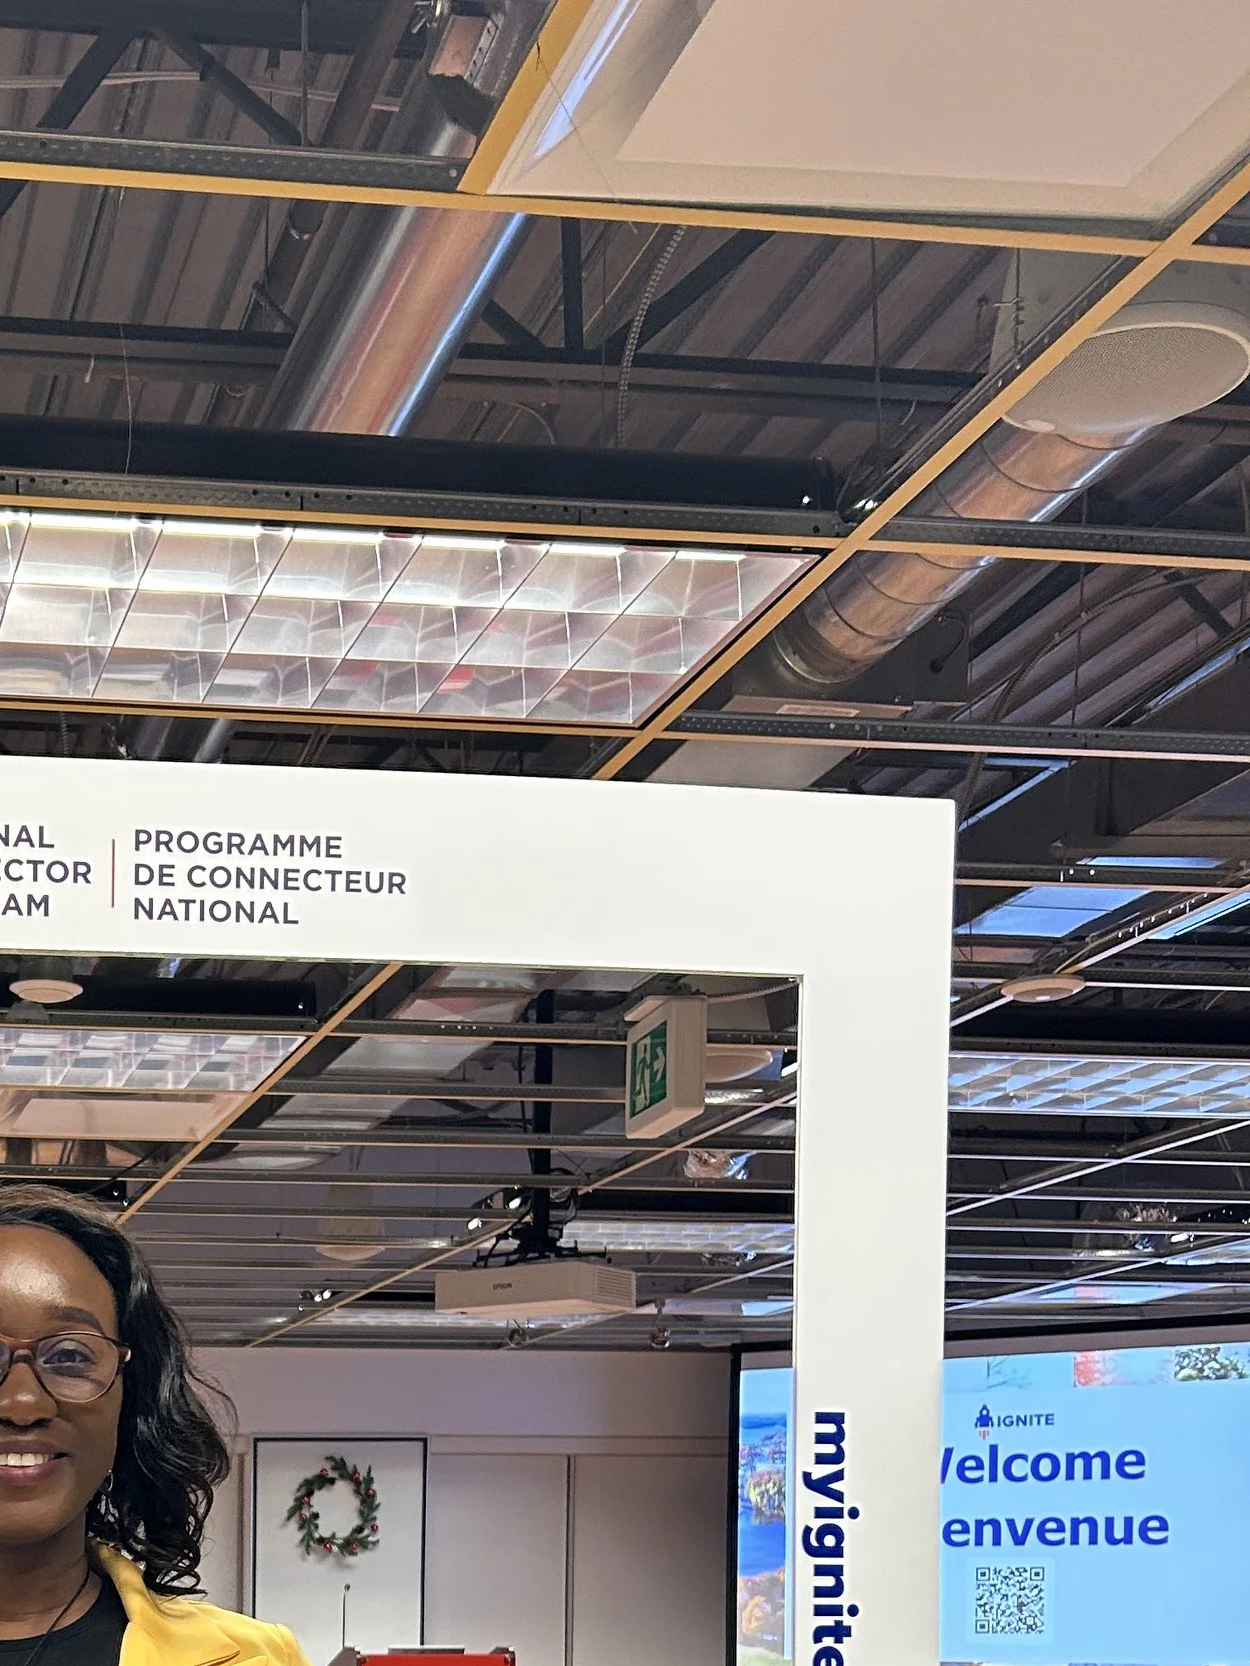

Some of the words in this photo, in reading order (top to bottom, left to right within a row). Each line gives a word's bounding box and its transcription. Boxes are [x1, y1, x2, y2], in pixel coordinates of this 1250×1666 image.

[134, 829, 343, 859] PROGRAMME
[134, 863, 176, 887] DE
[186, 865, 406, 895] CONNECTEUR
[133, 898, 299, 925] NATIONAL
[996, 1412, 1055, 1428] IGNITE
[941, 1514, 1170, 1548] envenue
